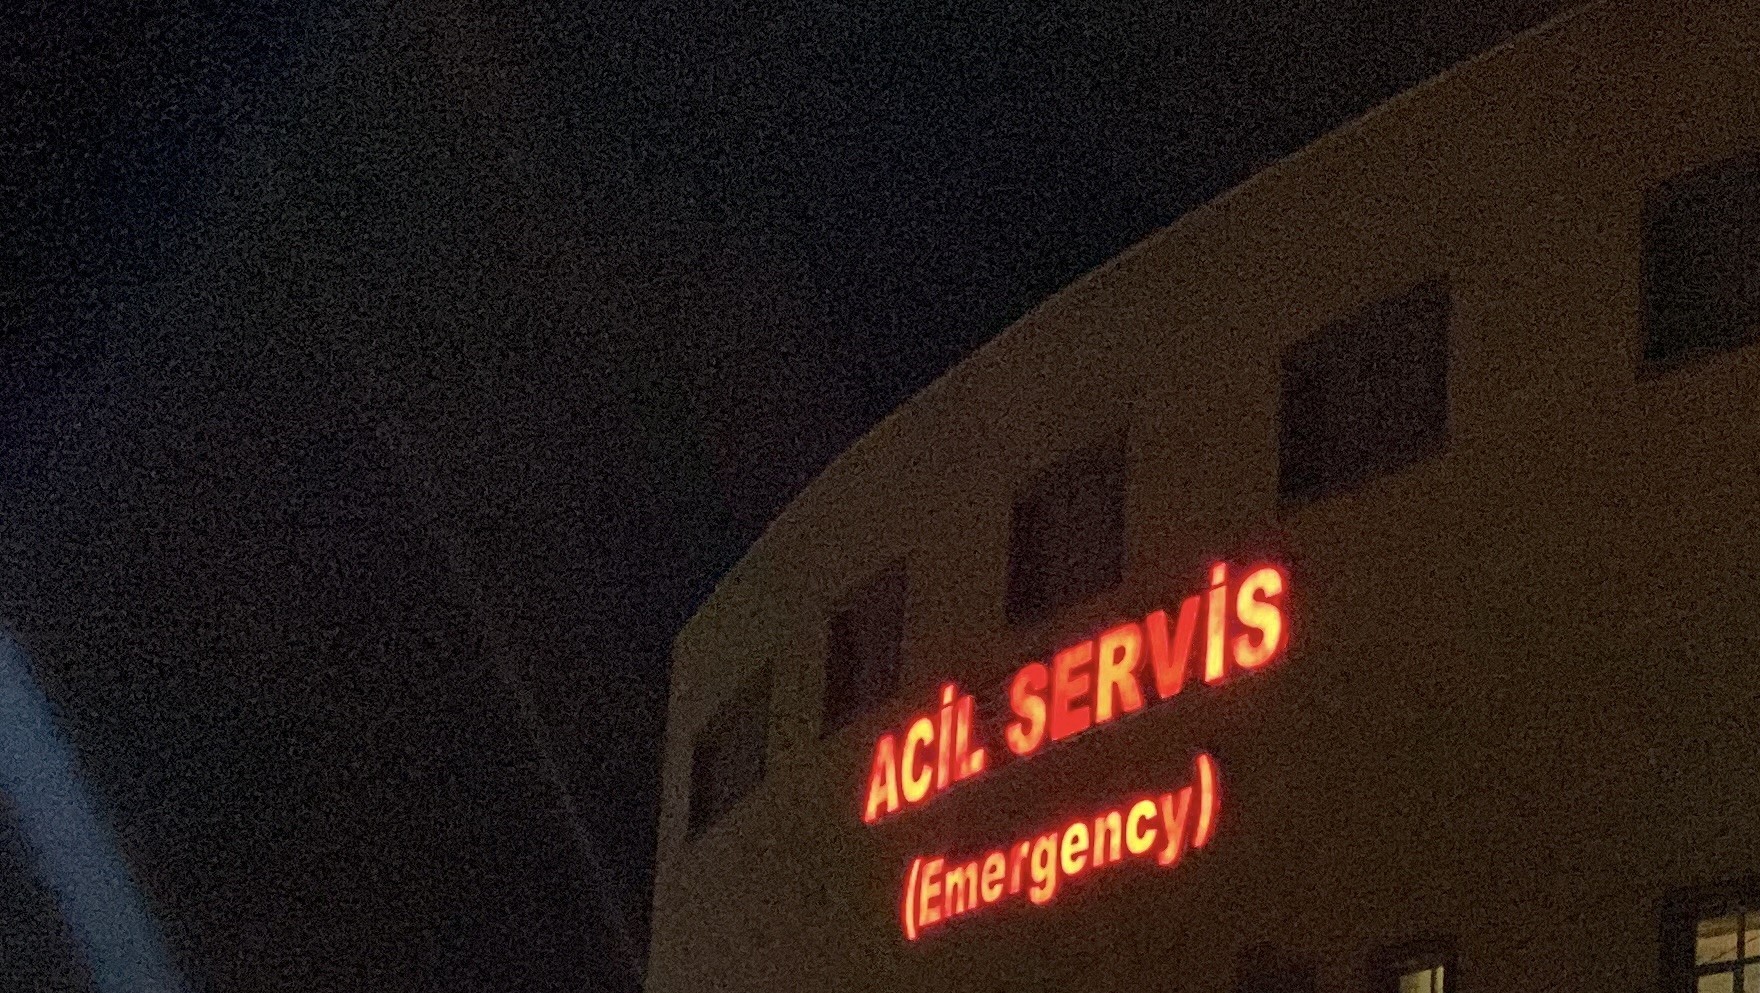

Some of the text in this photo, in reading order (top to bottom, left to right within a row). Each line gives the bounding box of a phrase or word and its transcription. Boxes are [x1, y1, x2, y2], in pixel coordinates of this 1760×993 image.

[864, 562, 1285, 822] ACİL SERVİS
[903, 753, 1216, 940] (Emergency)
